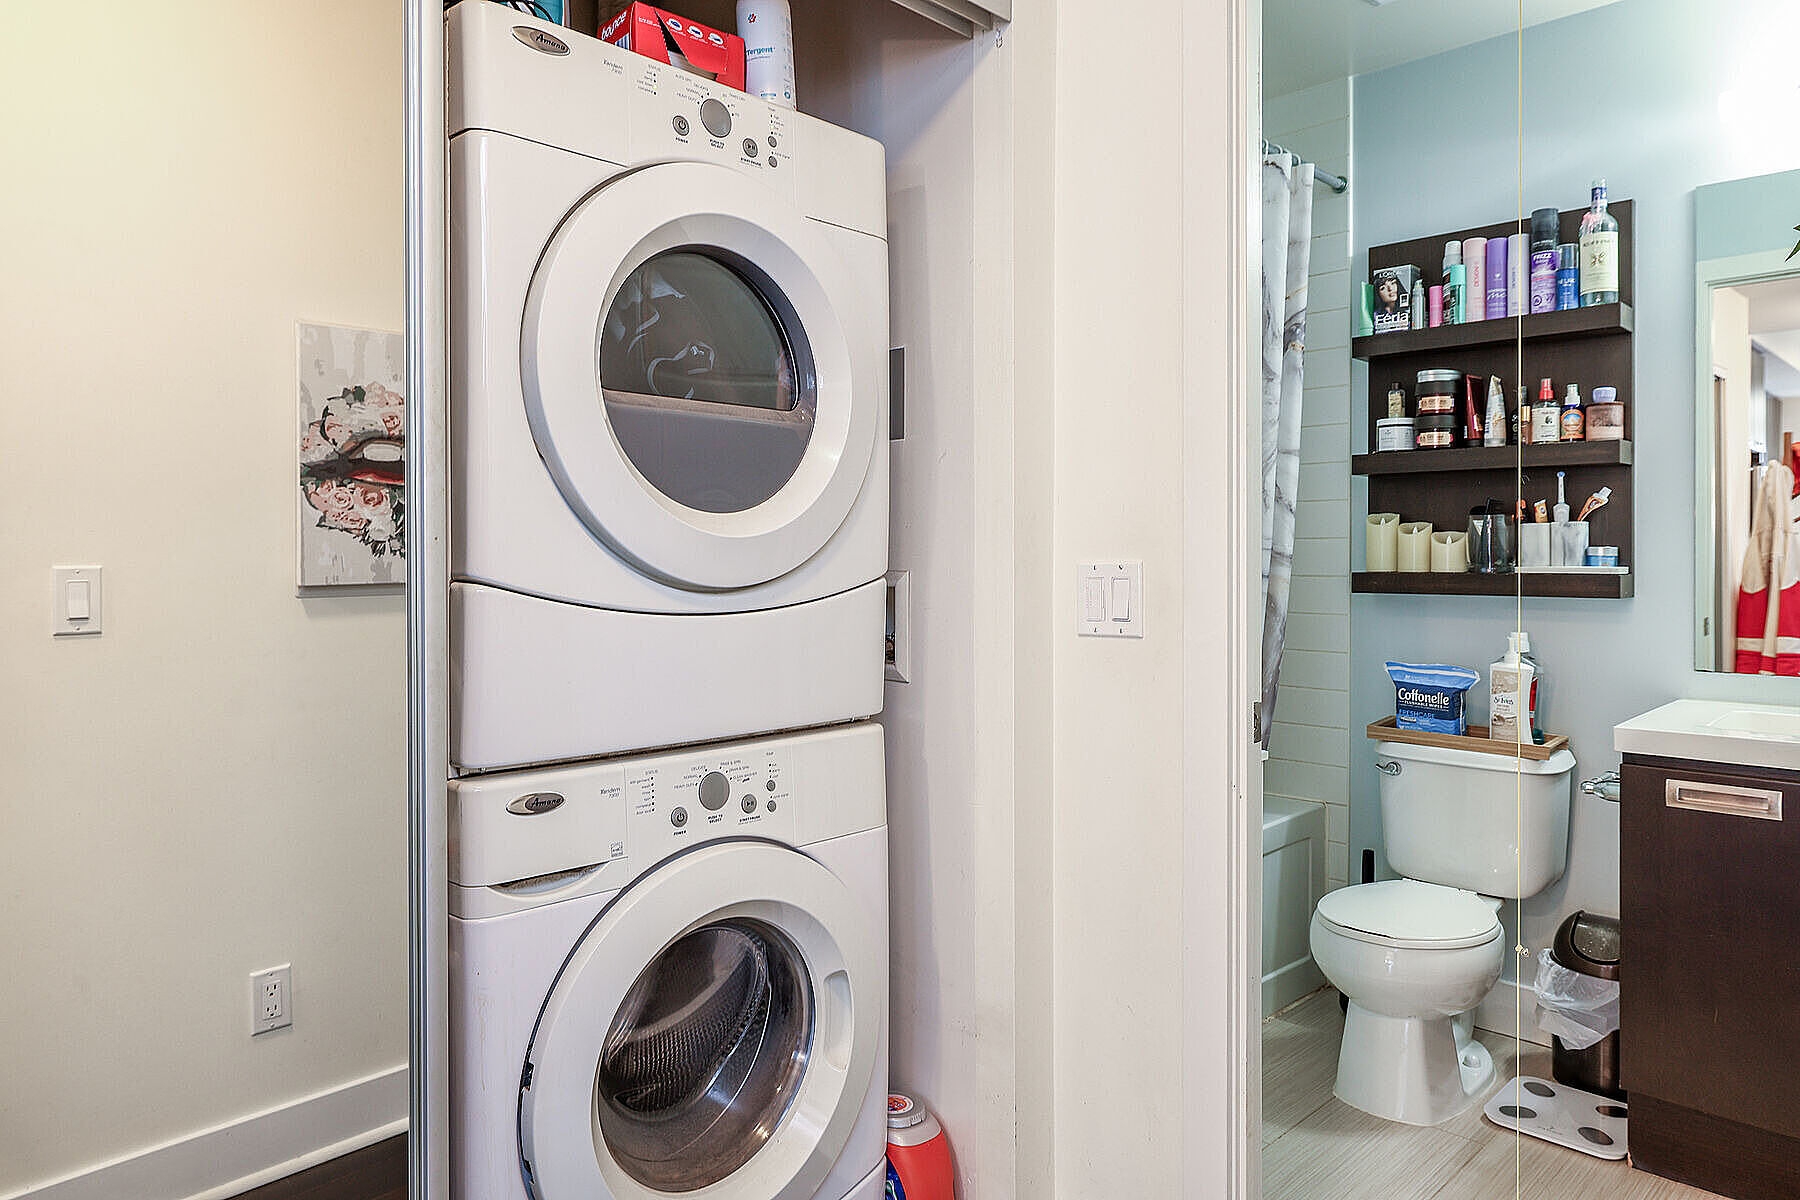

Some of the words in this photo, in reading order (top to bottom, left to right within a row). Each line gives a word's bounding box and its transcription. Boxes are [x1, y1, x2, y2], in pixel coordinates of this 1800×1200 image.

[600, 11, 628, 40] bounce
[536, 34, 566, 51] Amana
[1376, 312, 1409, 324] Féria
[1398, 687, 1450, 706] Cottonelle
[531, 797, 561, 809] Amana
